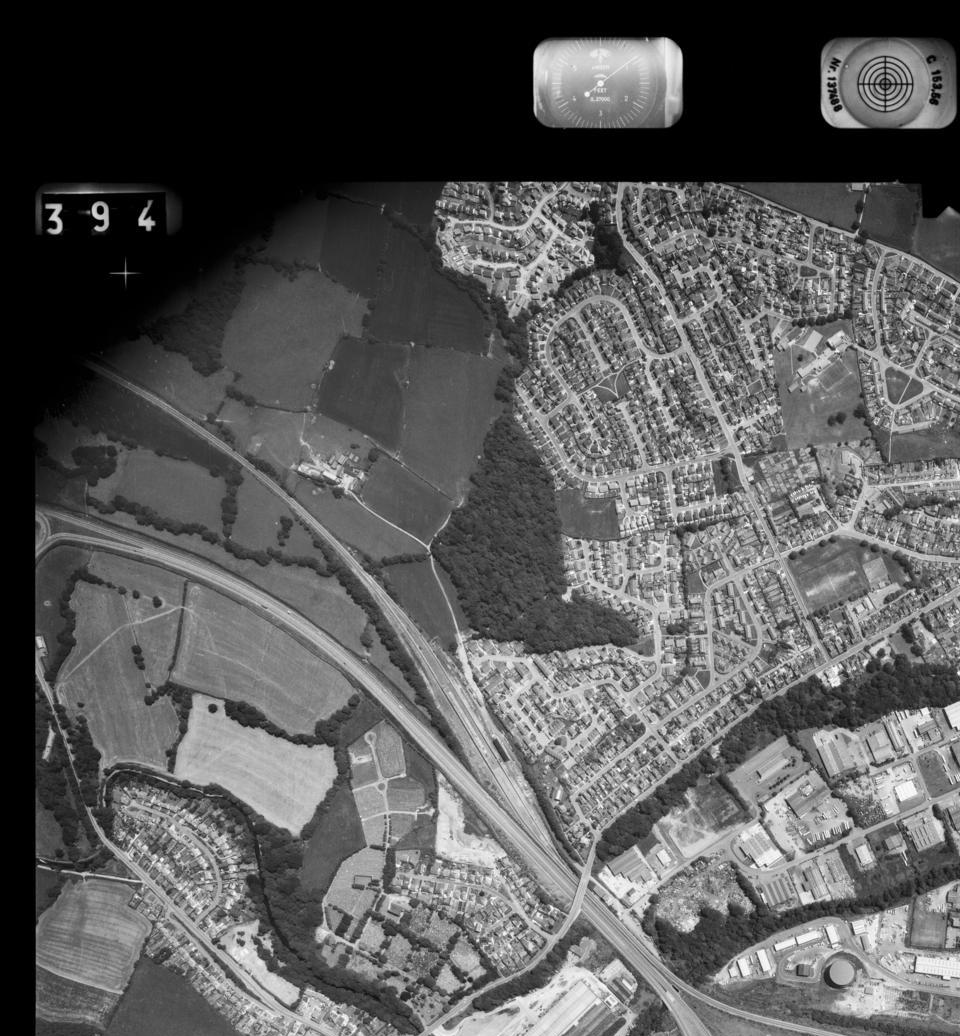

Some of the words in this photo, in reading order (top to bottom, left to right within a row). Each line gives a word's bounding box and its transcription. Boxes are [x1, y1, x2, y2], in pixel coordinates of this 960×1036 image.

[827, 57, 842, 73] Nr.
[926, 54, 937, 64] C
[826, 77, 843, 113] 137488
